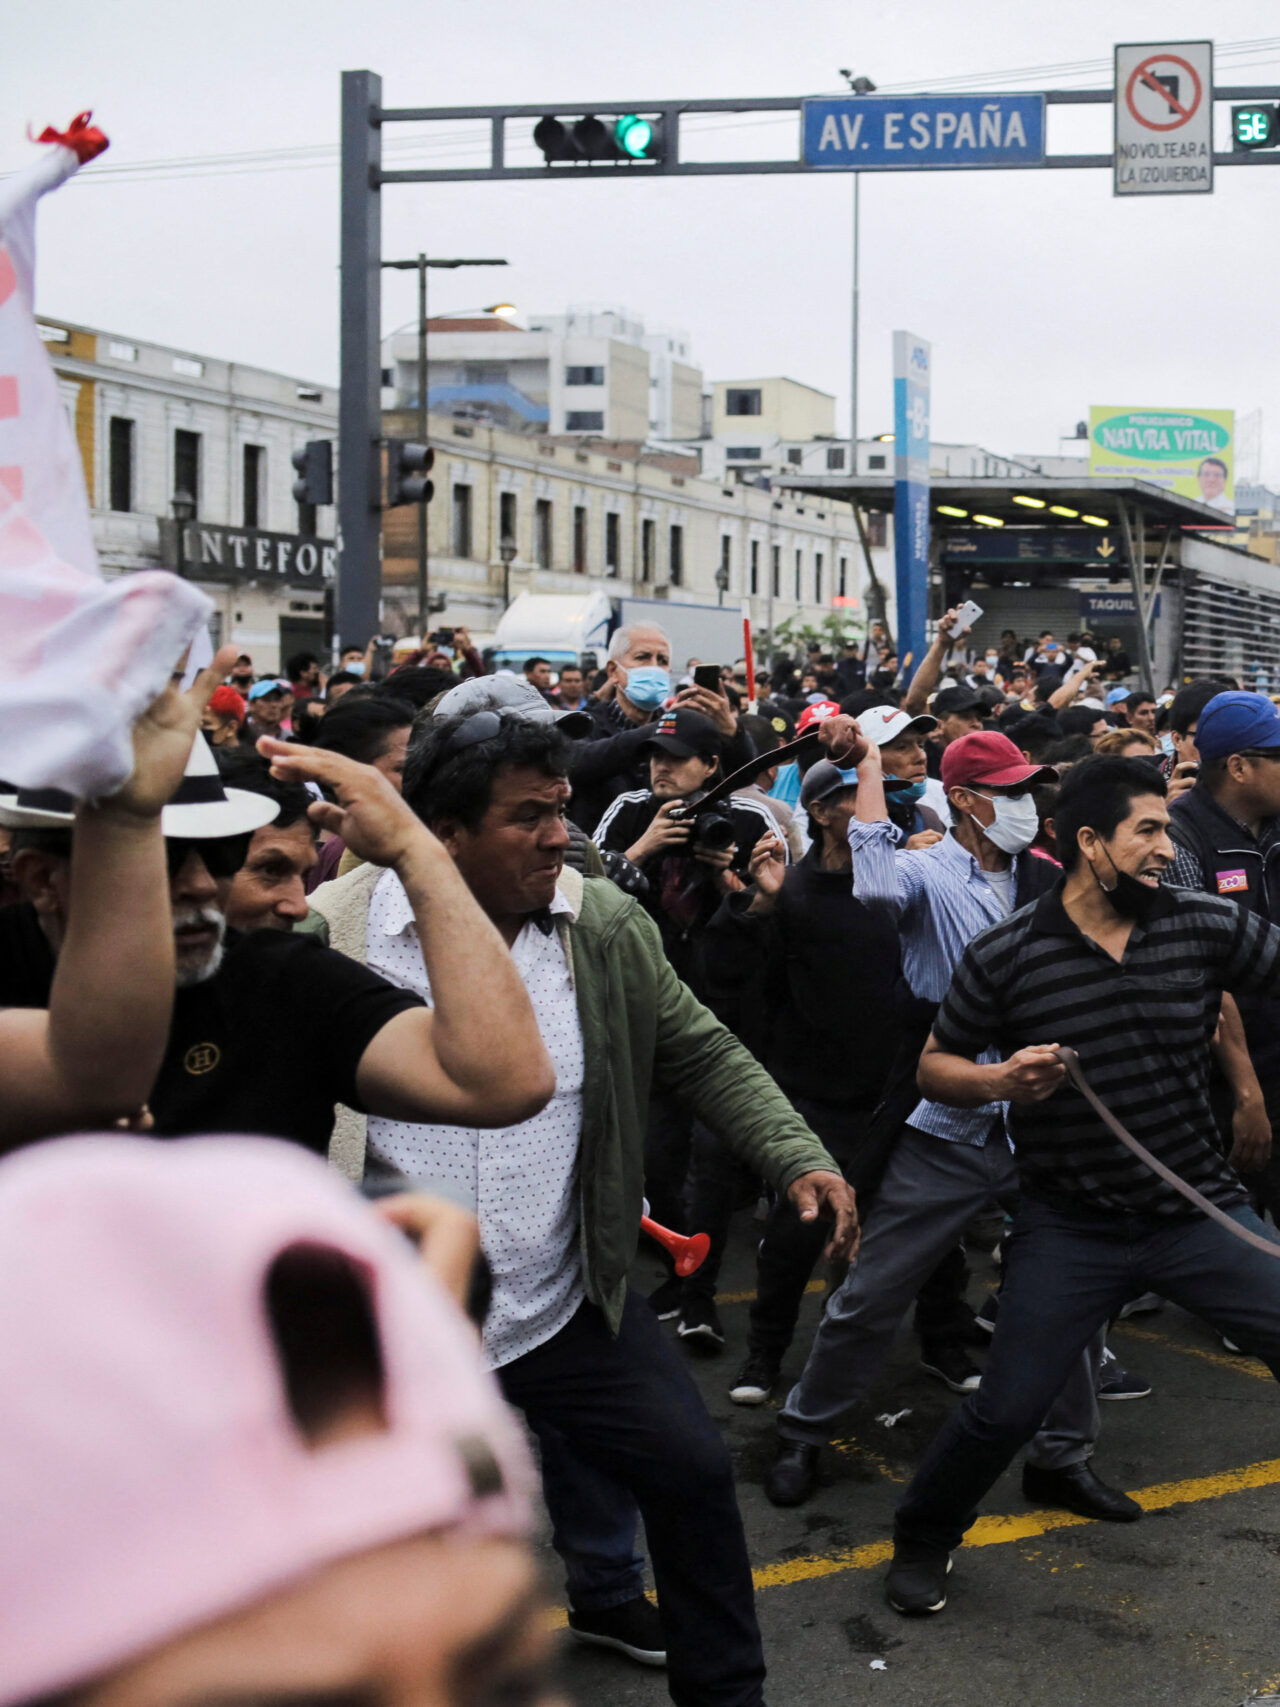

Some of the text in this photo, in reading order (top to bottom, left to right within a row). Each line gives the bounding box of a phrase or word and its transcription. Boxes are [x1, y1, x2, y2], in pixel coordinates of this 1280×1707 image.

[818, 104, 1027, 151] AV. ESPAÑA
[1119, 143, 1137, 159] NO
[1137, 142, 1197, 159] VOLTEAR
[1119, 166, 1208, 184] LA IZQUIERDA
[1173, 429, 1220, 453] VITAL
